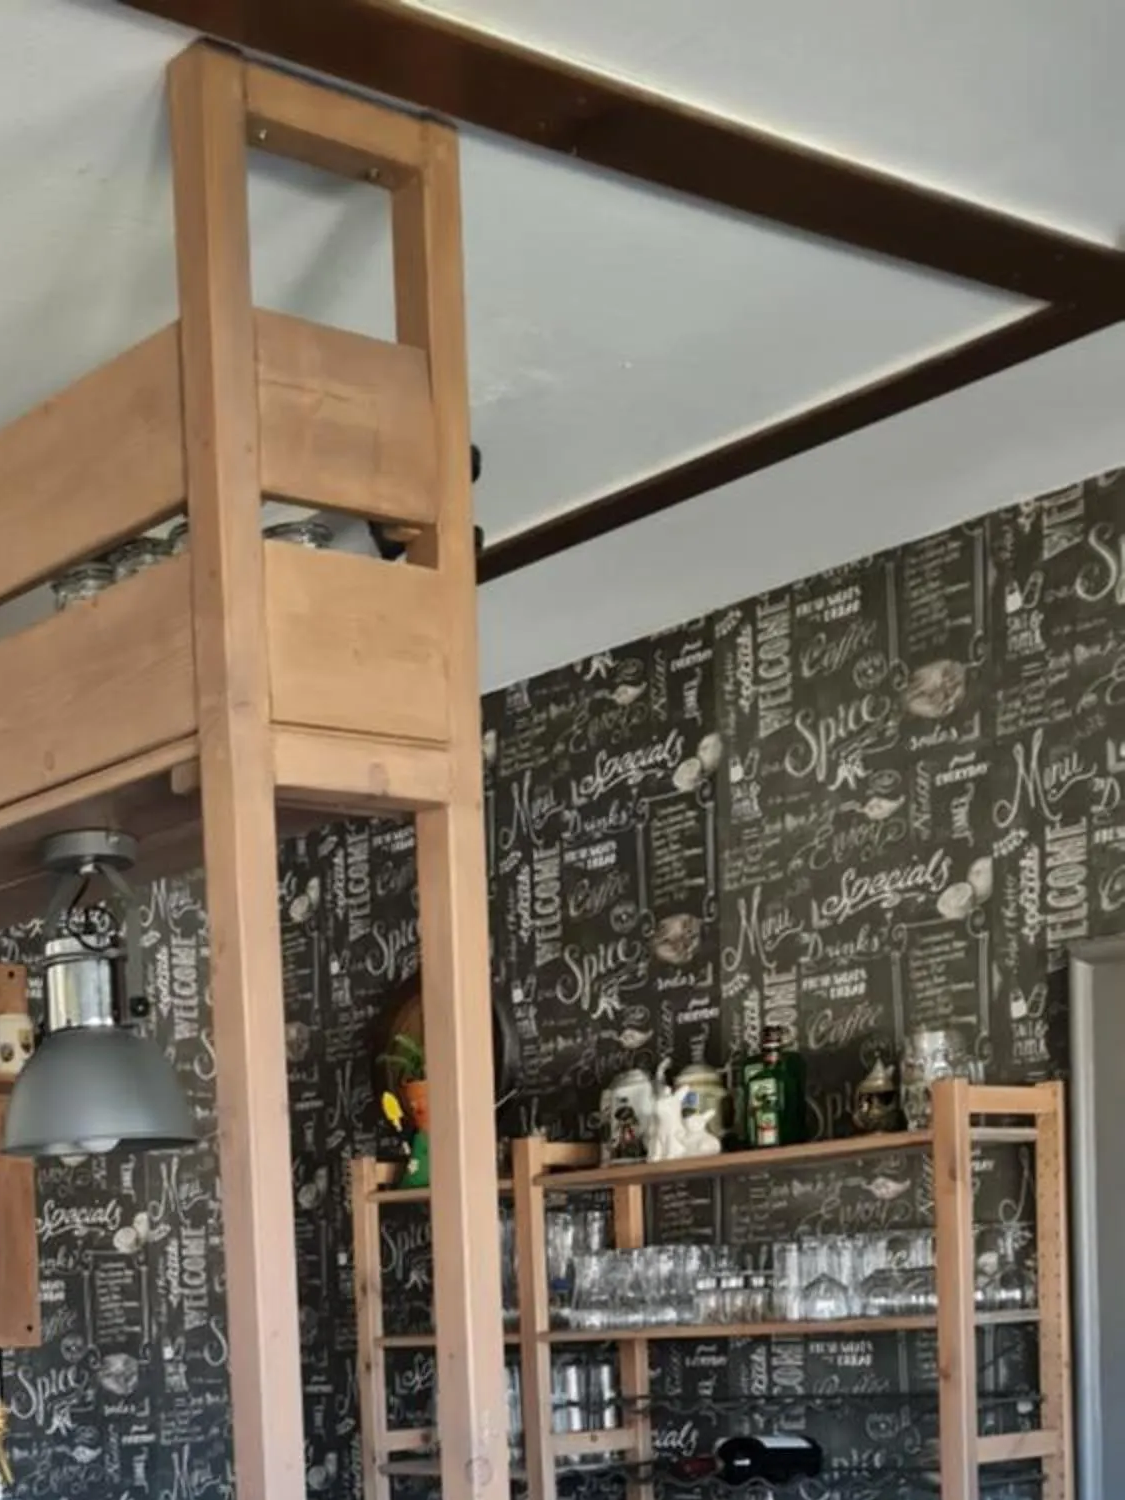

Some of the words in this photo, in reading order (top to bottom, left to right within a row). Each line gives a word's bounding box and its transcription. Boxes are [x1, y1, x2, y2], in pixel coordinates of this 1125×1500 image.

[756, 595, 794, 739] WELCOME
[580, 728, 685, 800] Specials
[785, 693, 891, 783] Spice
[993, 728, 1098, 829] Menu
[533, 841, 563, 968] WELCOME
[721, 885, 805, 972] Menu
[822, 849, 952, 924] Specials
[171, 935, 199, 1040] WELCOME
[36, 1199, 123, 1243] Specials
[180, 1225, 208, 1331] WELCOME
[11, 1365, 89, 1426] Spice
